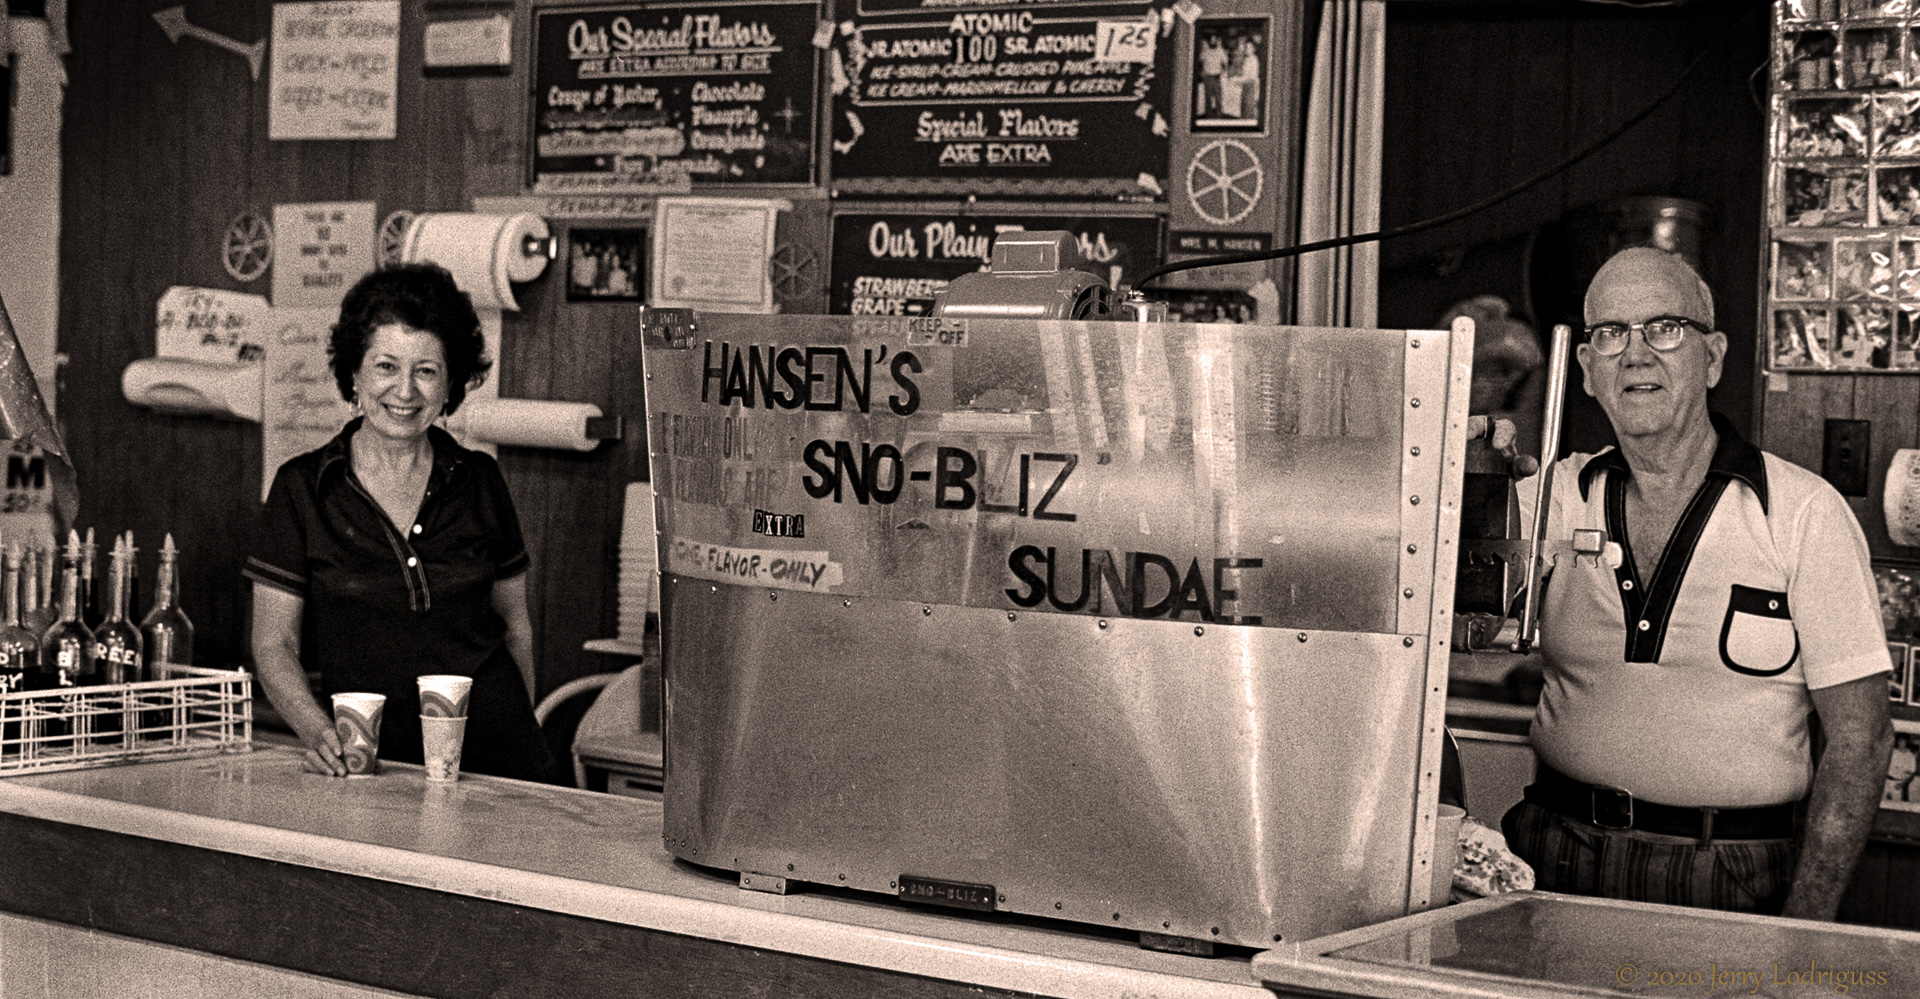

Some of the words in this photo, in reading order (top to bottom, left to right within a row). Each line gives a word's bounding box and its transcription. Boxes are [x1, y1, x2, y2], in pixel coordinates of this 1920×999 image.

[568, 19, 609, 54] Our
[611, 14, 692, 50] Special
[694, 14, 776, 48] Flavors
[949, 12, 1033, 36] ATOMIC
[954, 35, 998, 64] 100
[917, 110, 987, 142] Special
[998, 108, 1079, 137] Flavors
[939, 143, 982, 164] ARE
[985, 143, 1052, 164] EXTRA
[868, 221, 919, 258] Our
[924, 220, 991, 263] Plain
[908, 318, 942, 333] KEEP
[938, 330, 964, 344] OFF
[700, 340, 923, 417] HANSEN'S
[802, 438, 1078, 522] SNO-BLIZ
[752, 508, 805, 538] EXTRA
[1004, 544, 1263, 626] SUNDAE
